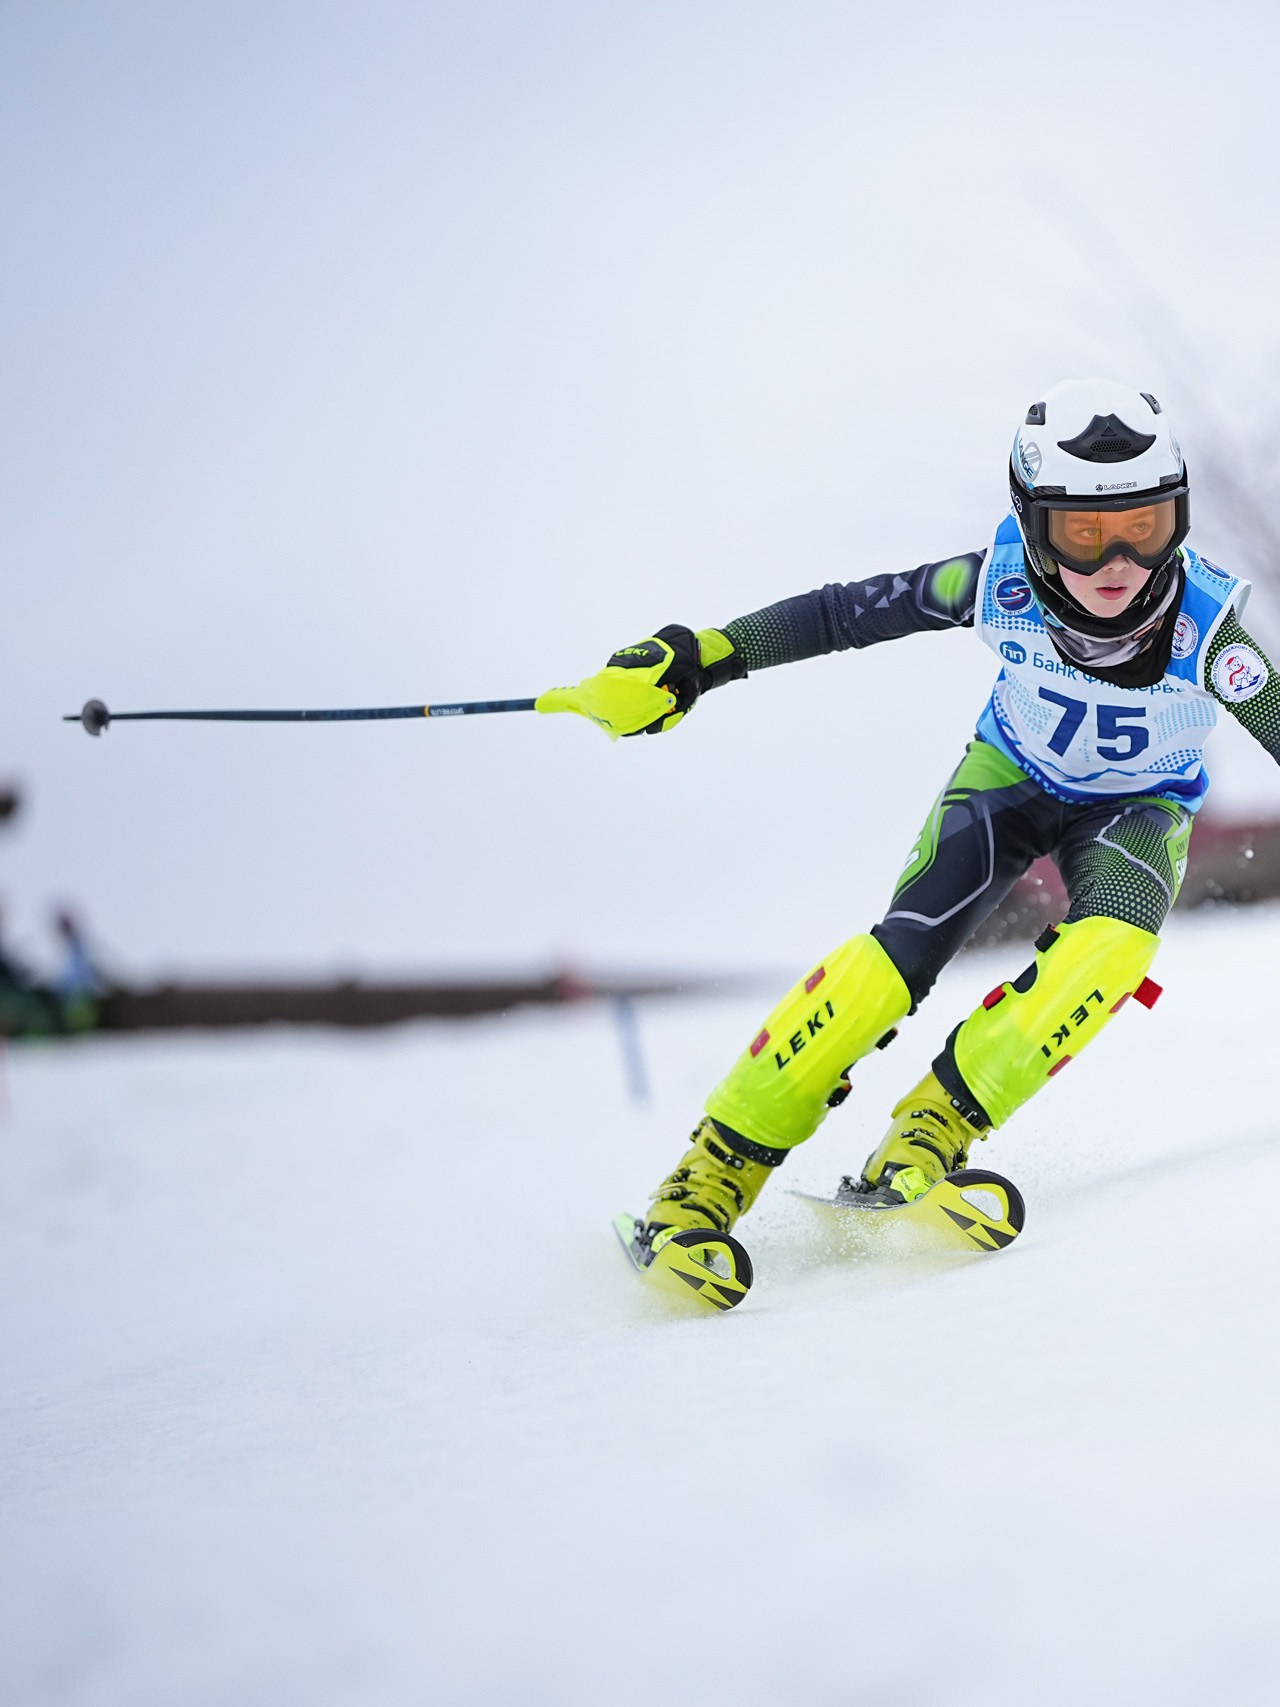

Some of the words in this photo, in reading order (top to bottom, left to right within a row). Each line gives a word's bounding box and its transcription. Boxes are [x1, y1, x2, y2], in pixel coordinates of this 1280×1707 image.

[1103, 481, 1137, 491] LANGE
[615, 647, 649, 657] LEKI
[1033, 652, 1078, 681] Банк
[1038, 686, 1149, 762] 75
[774, 1000, 835, 1071] LEKI
[1041, 989, 1105, 1058] LEKI
